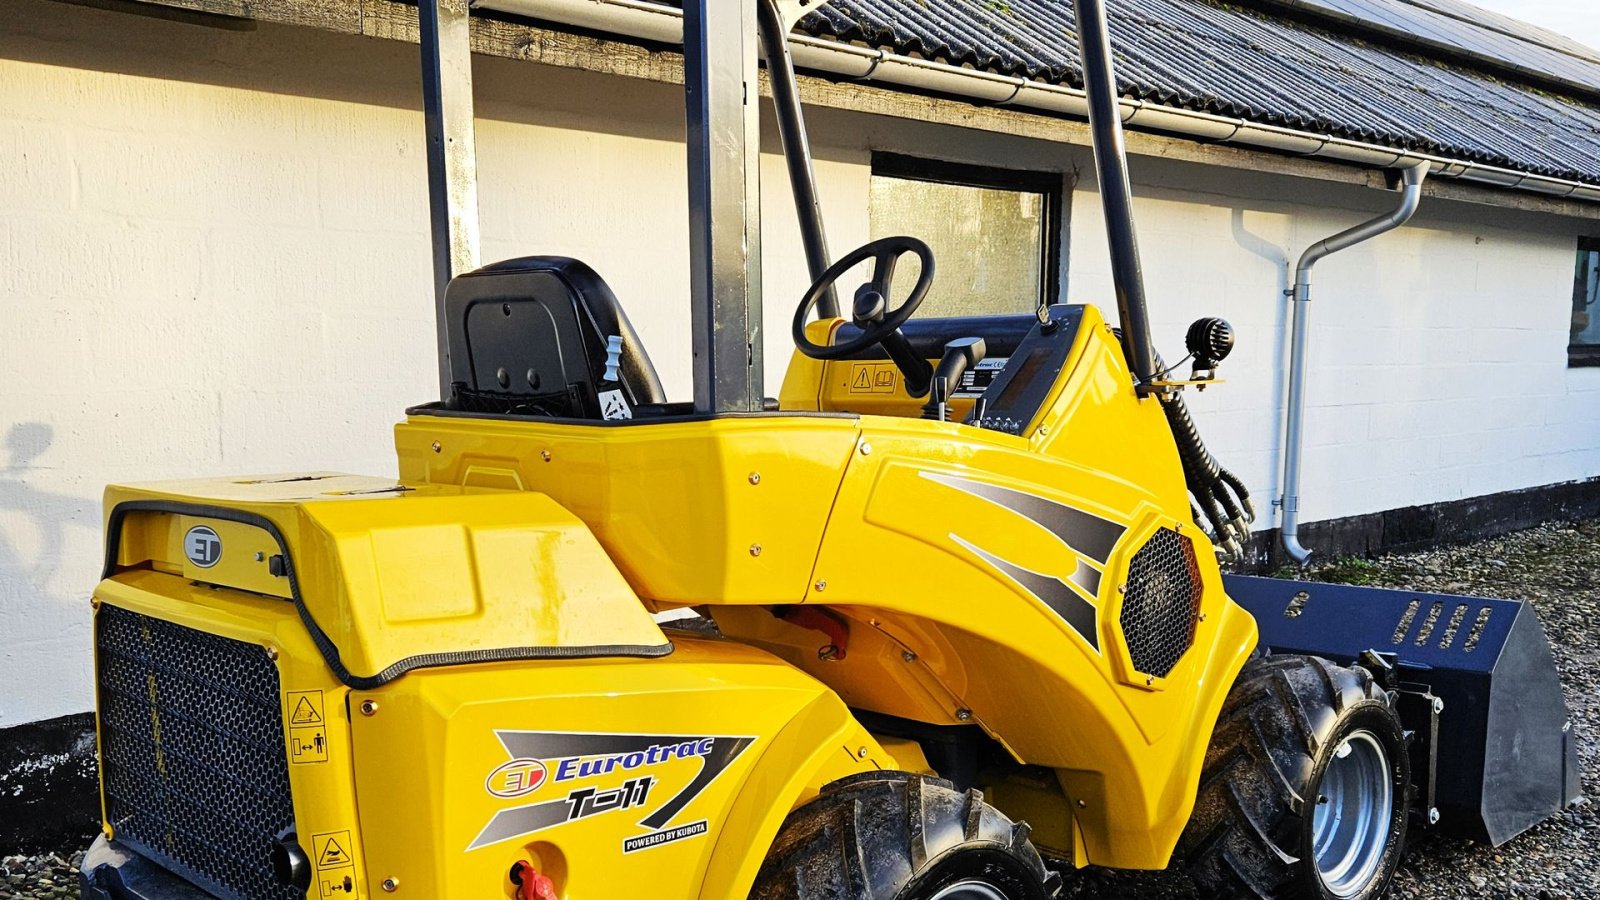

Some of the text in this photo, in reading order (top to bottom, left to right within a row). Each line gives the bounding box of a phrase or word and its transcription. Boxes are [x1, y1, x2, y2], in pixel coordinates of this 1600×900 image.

[187, 532, 219, 561] ET
[496, 738, 714, 792] ET Eurotrac
[567, 776, 653, 820] T-11
[626, 823, 705, 850] POWERED BY KUBOTA
